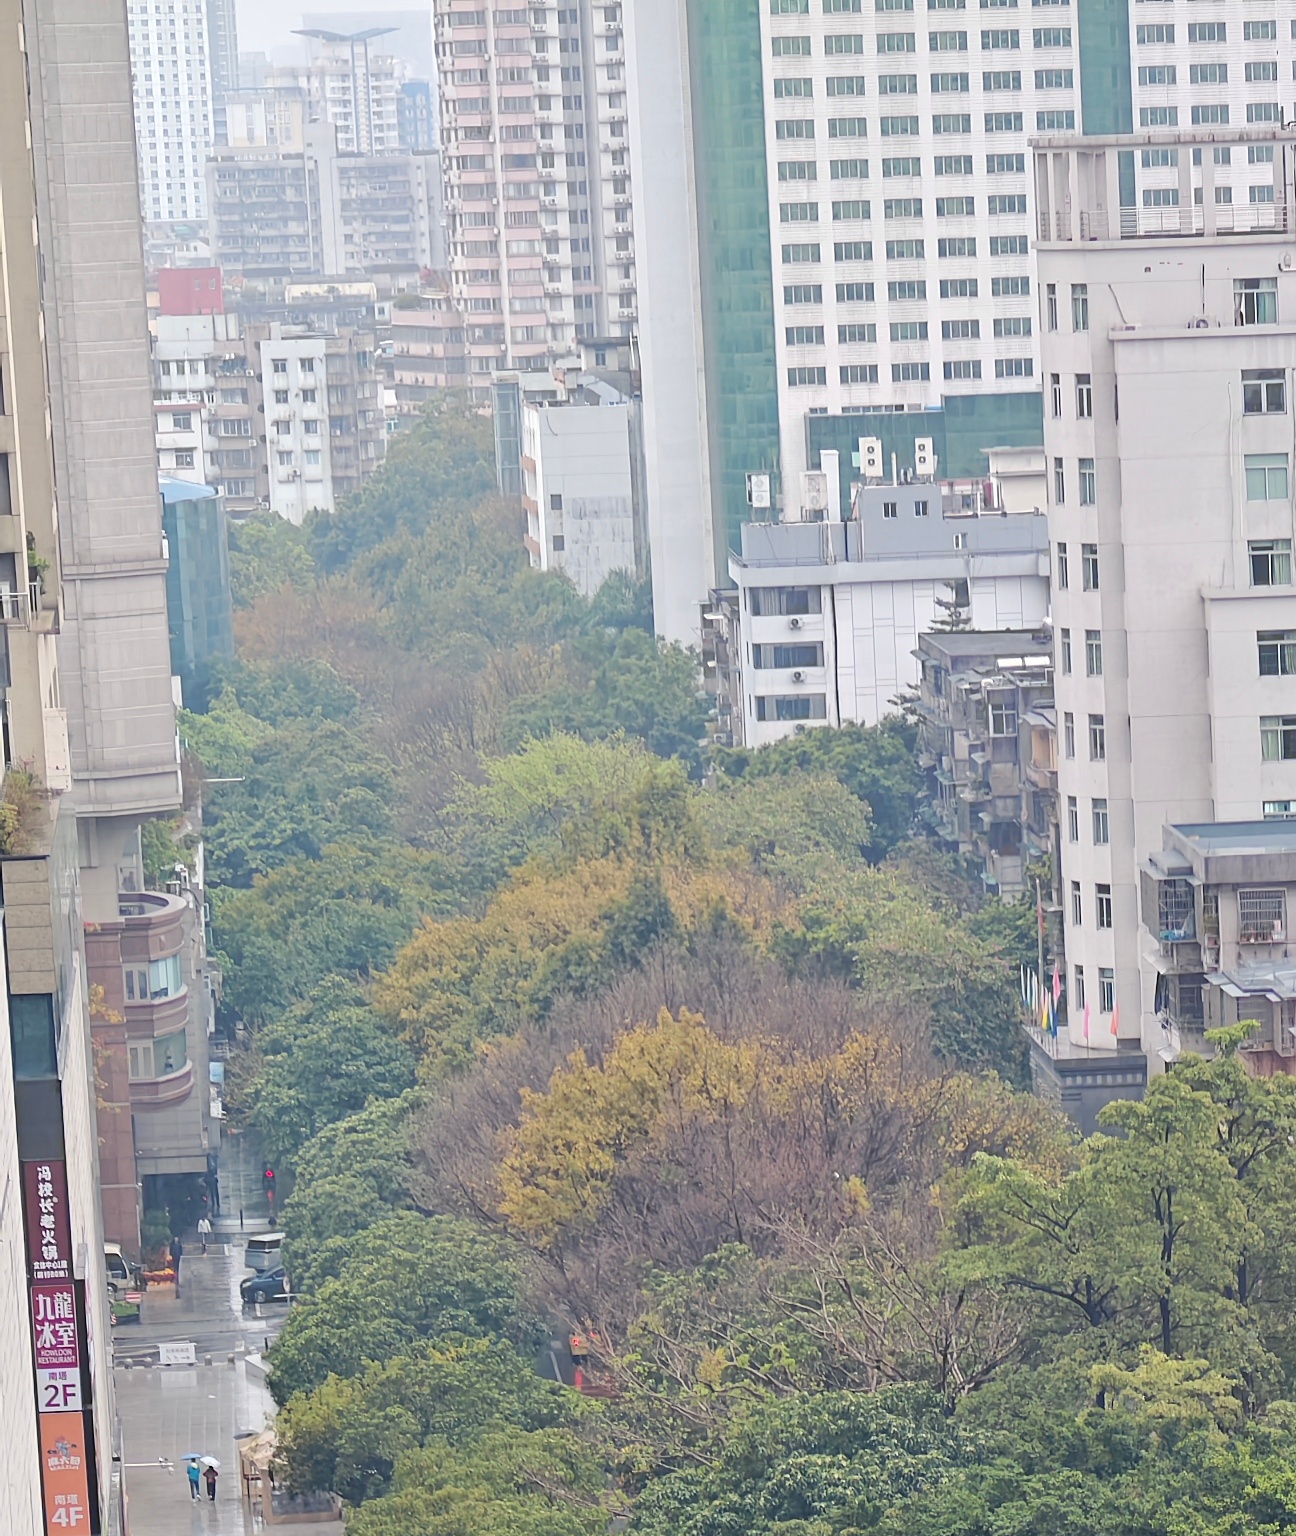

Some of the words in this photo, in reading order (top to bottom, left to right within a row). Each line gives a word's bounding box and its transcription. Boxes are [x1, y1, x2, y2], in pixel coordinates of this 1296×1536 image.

[37, 1166, 58, 1260] 冯校长老火锅
[36, 1291, 73, 1320] 九龍
[35, 1321, 75, 1348] 冰室
[44, 1384, 76, 1407] 2F
[54, 1494, 78, 1505] 南塔
[51, 1506, 84, 1528] 4F
